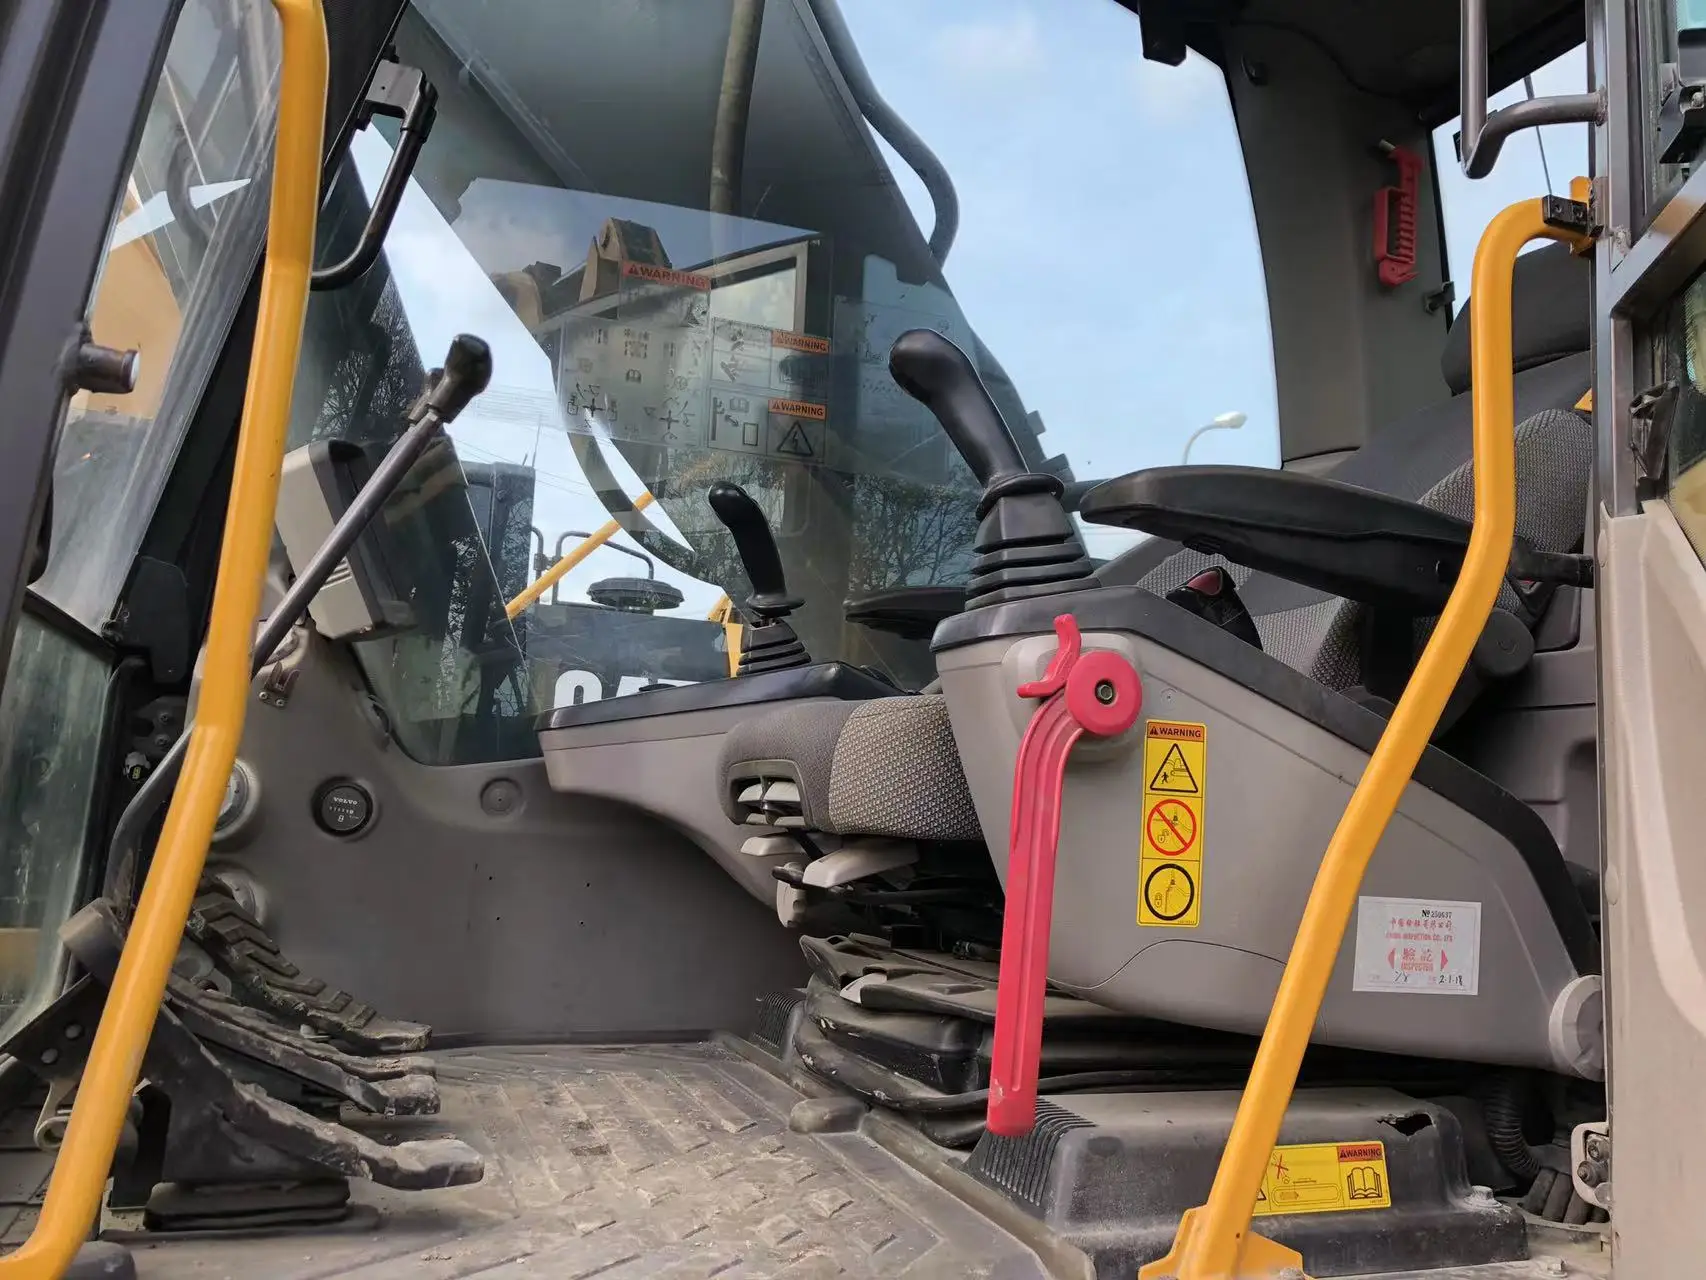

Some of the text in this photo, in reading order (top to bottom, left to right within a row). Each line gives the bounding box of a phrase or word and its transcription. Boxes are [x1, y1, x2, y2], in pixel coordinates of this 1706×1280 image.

[640, 265, 706, 289] WARNING
[781, 402, 824, 416] WARNING
[1159, 727, 1202, 738] WARNING
[333, 796, 358, 805] VOLVO
[1346, 1148, 1382, 1158] WARNING
